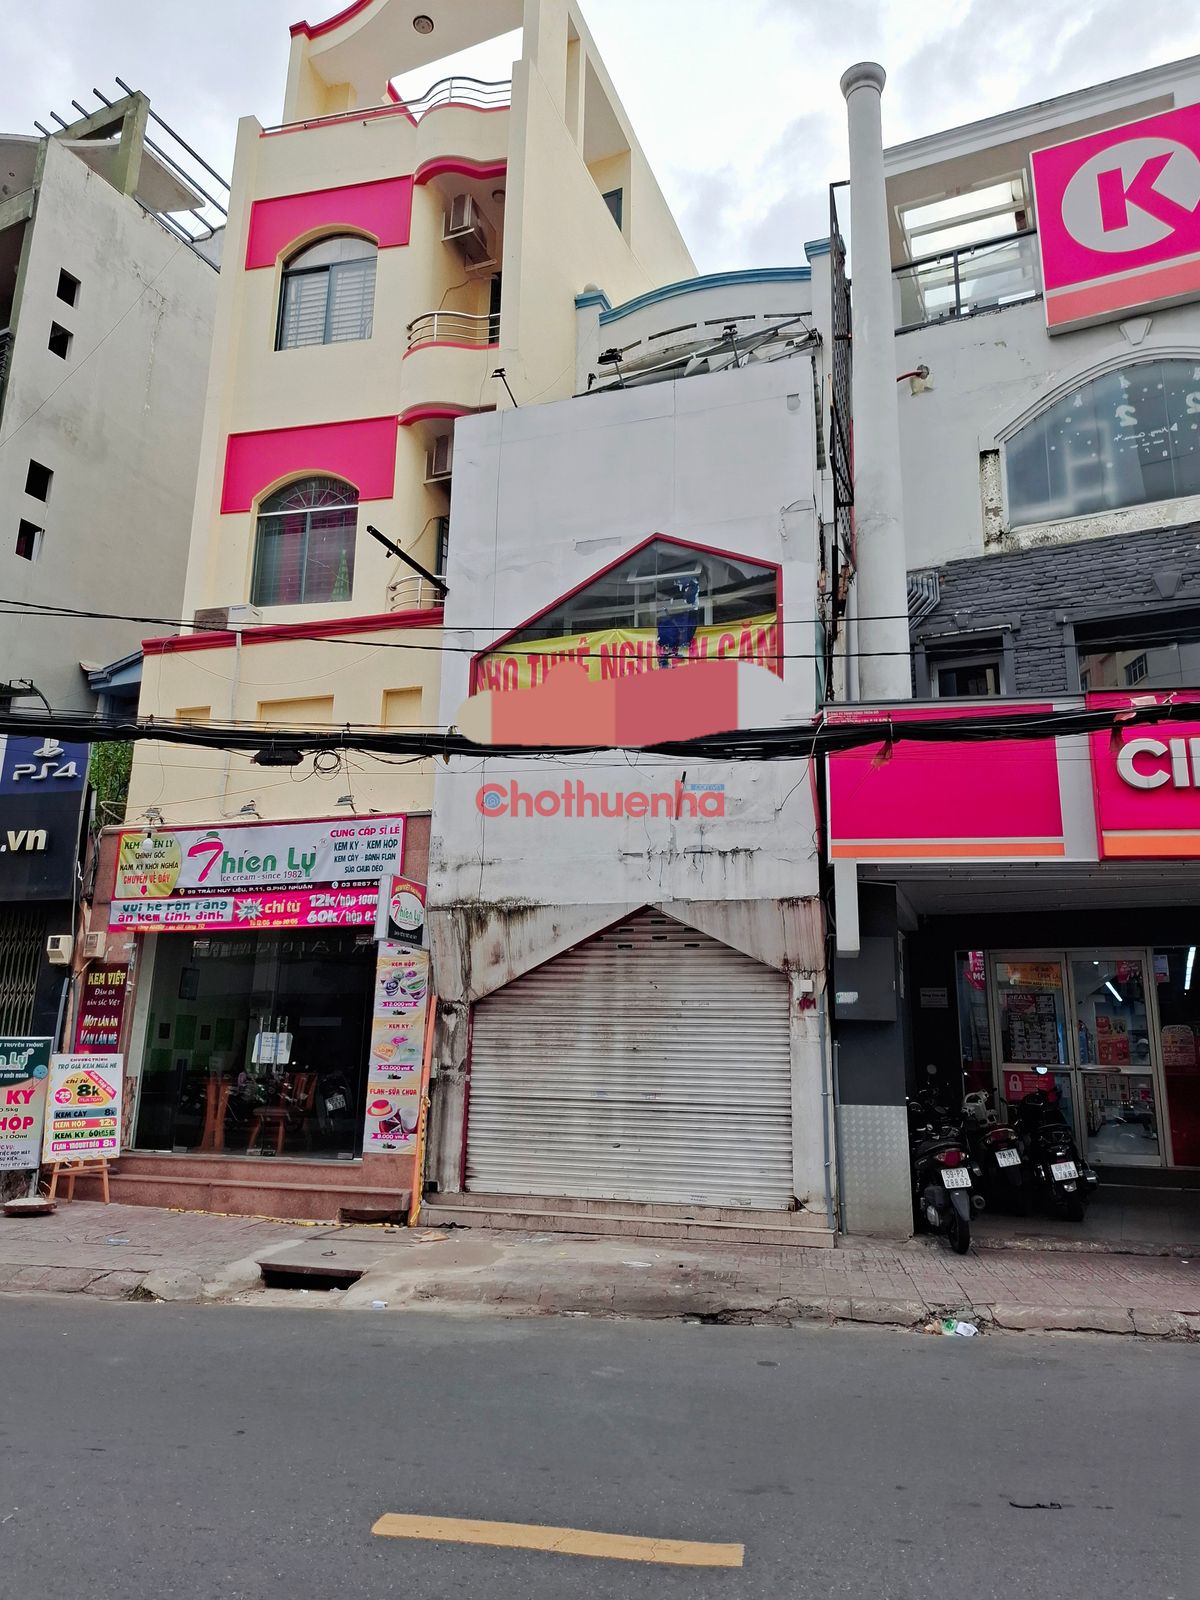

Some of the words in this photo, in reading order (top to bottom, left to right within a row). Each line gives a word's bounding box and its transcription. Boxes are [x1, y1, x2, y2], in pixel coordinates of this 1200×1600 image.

[1097, 151, 1194, 233] K
[1117, 737, 1200, 789] CI
[13, 761, 78, 780] PS4
[330, 829, 355, 838] CUNG
[1, 829, 47, 852] .vn
[334, 841, 348, 851] KEM
[366, 839, 382, 849] KEM
[334, 855, 346, 863] KEM
[283, 870, 302, 879] 1982
[138, 913, 160, 922] kem
[88, 973, 105, 985] KEM
[55, 1111, 72, 1119] KEM
[54, 1132, 72, 1140] KEM
